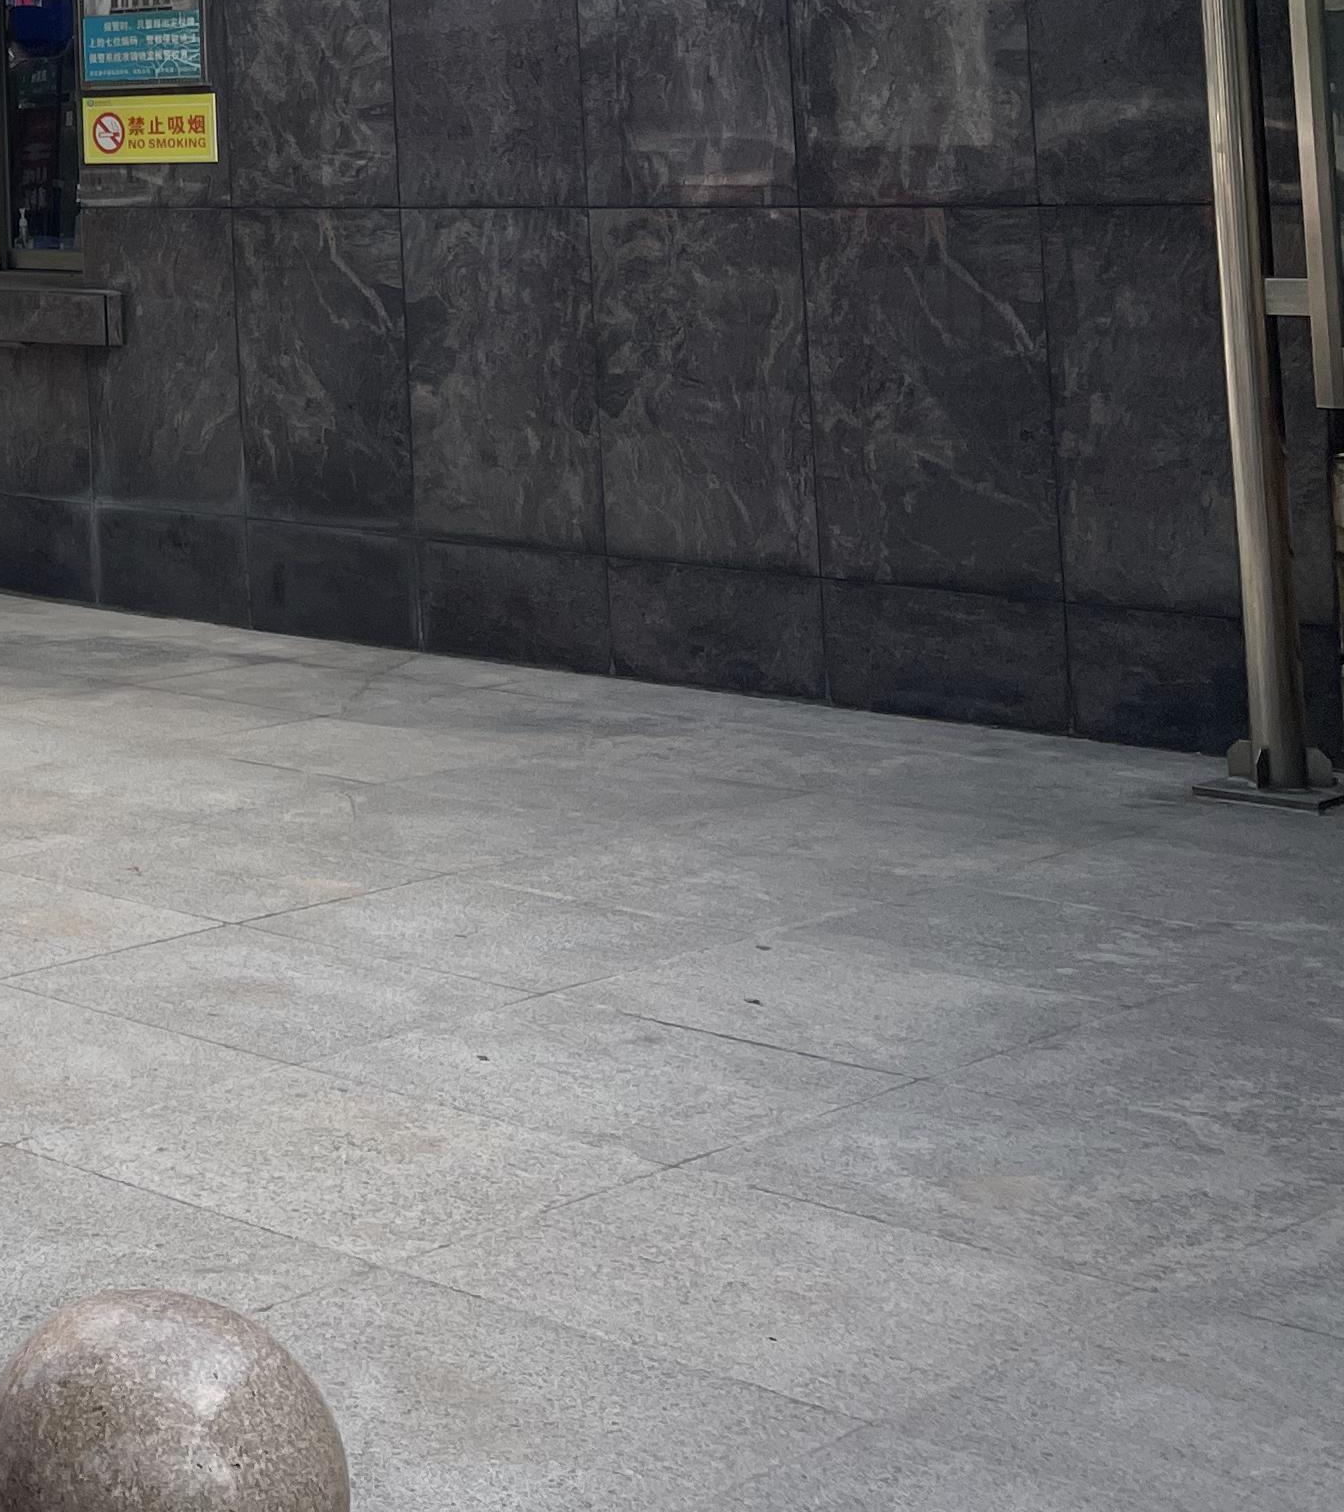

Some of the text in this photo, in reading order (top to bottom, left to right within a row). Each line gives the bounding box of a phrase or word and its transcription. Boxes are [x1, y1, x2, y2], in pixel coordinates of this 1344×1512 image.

[127, 114, 207, 137] 禁止吸烟
[127, 137, 207, 150] NO SMOKING
